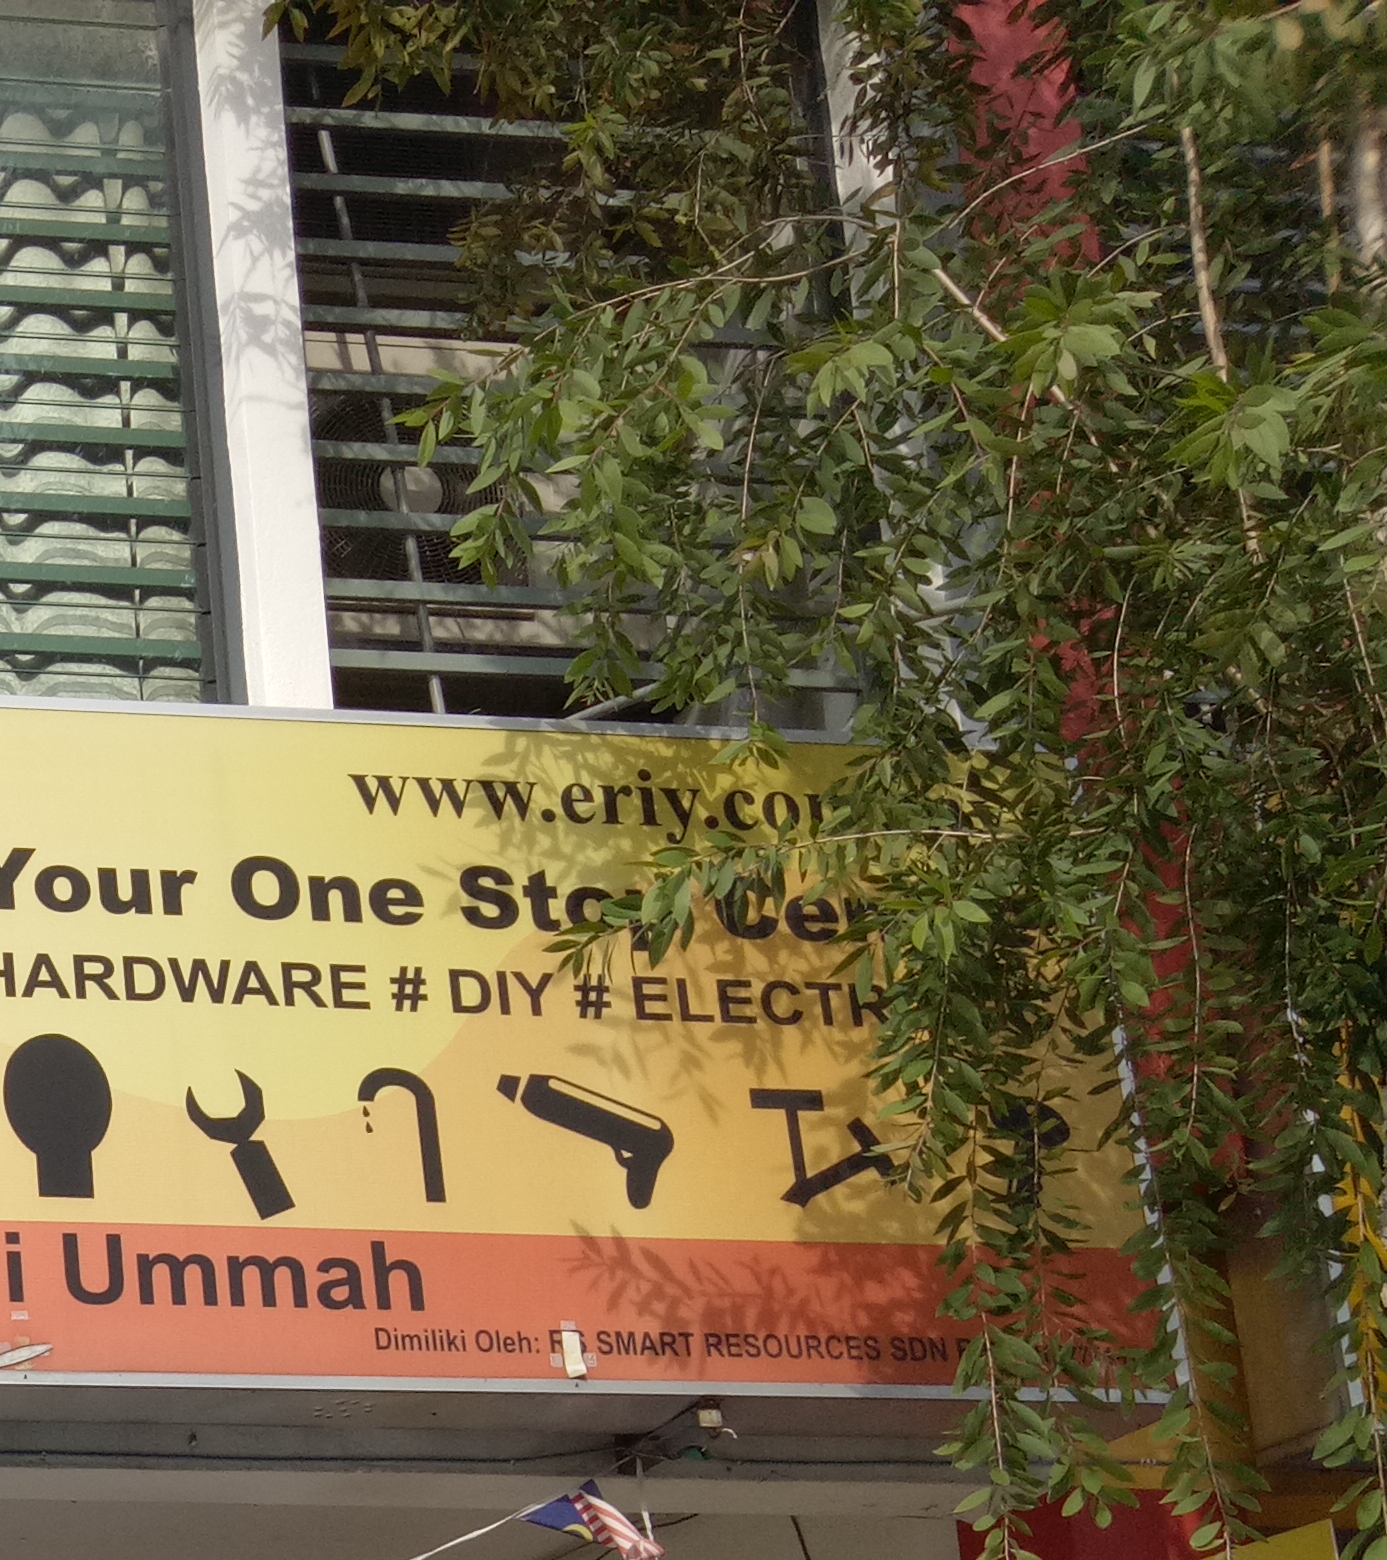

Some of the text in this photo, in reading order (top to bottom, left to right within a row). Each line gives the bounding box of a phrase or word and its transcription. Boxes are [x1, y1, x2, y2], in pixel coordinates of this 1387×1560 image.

[231, 855, 425, 926] One
[448, 968, 554, 1017] DIY
[63, 1233, 426, 1313] Ummah
[374, 1327, 467, 1352] Dimiliki
[475, 1329, 540, 1353] Oleh:
[597, 1331, 694, 1357] SMART
[705, 1333, 881, 1361] RESOURCES
[890, 1336, 949, 1362] SDN
